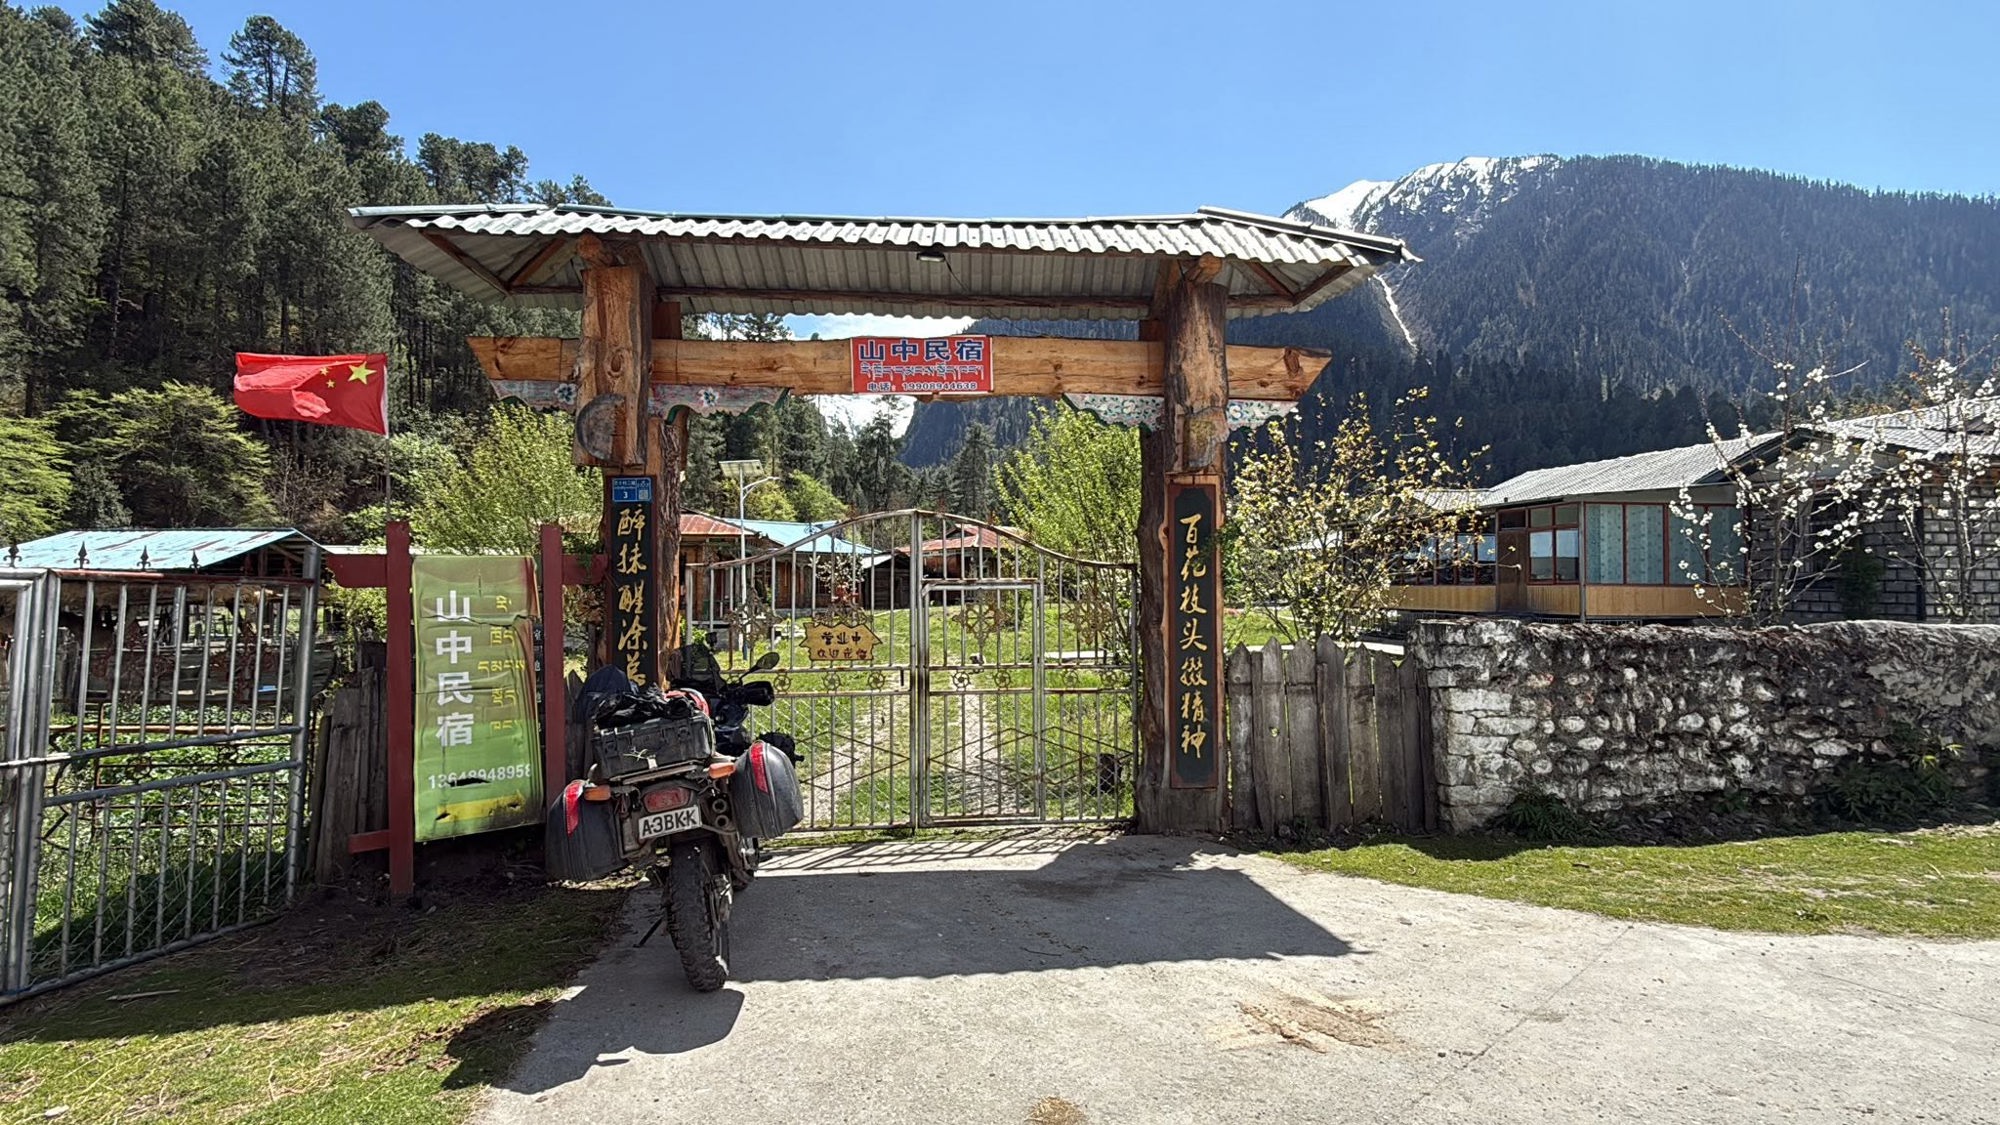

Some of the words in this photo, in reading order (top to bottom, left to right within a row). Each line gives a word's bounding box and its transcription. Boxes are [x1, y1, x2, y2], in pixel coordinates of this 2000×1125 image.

[859, 339, 983, 361] 山中民宿
[821, 632, 861, 645] 营业中
[435, 590, 475, 747] 山中民宿
